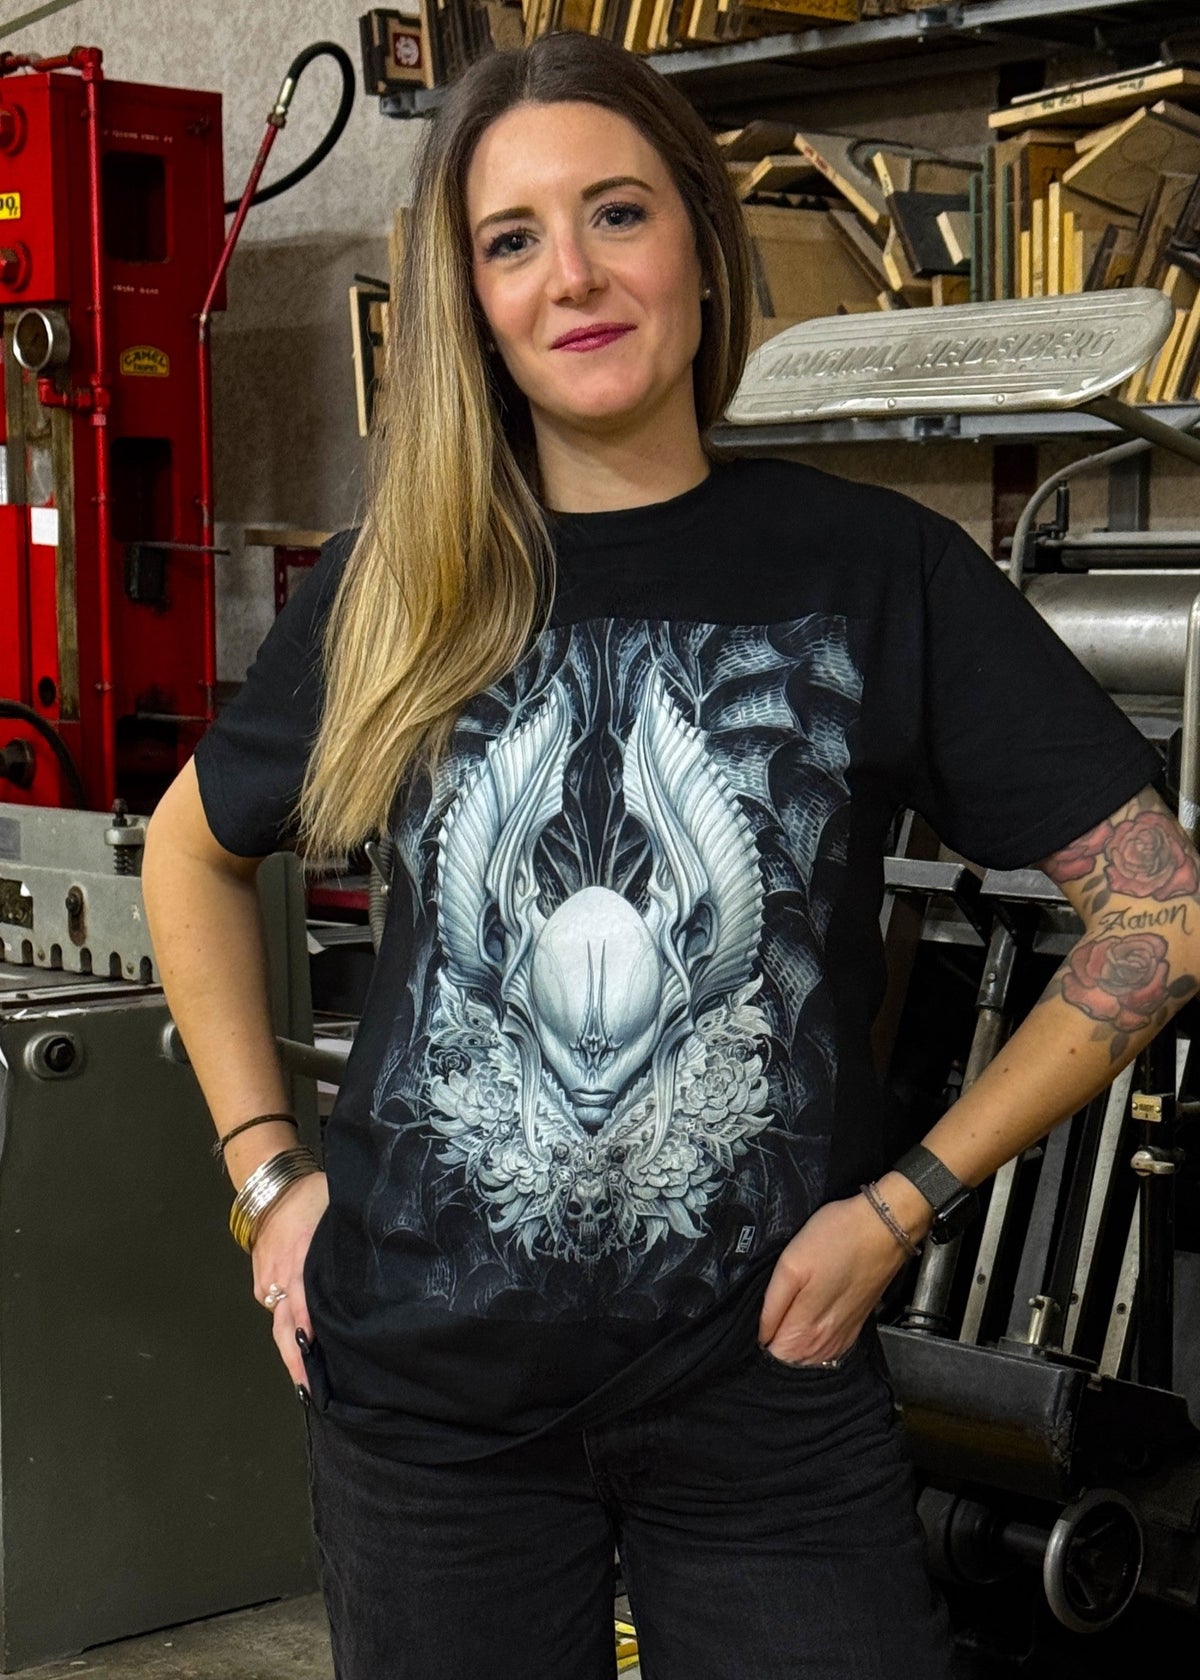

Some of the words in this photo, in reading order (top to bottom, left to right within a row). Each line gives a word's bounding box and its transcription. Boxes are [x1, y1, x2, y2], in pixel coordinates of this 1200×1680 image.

[764, 343, 909, 380] ORIGINAL
[916, 327, 1120, 368] HEIDELBERG
[1096, 903, 1195, 937] Aaron
